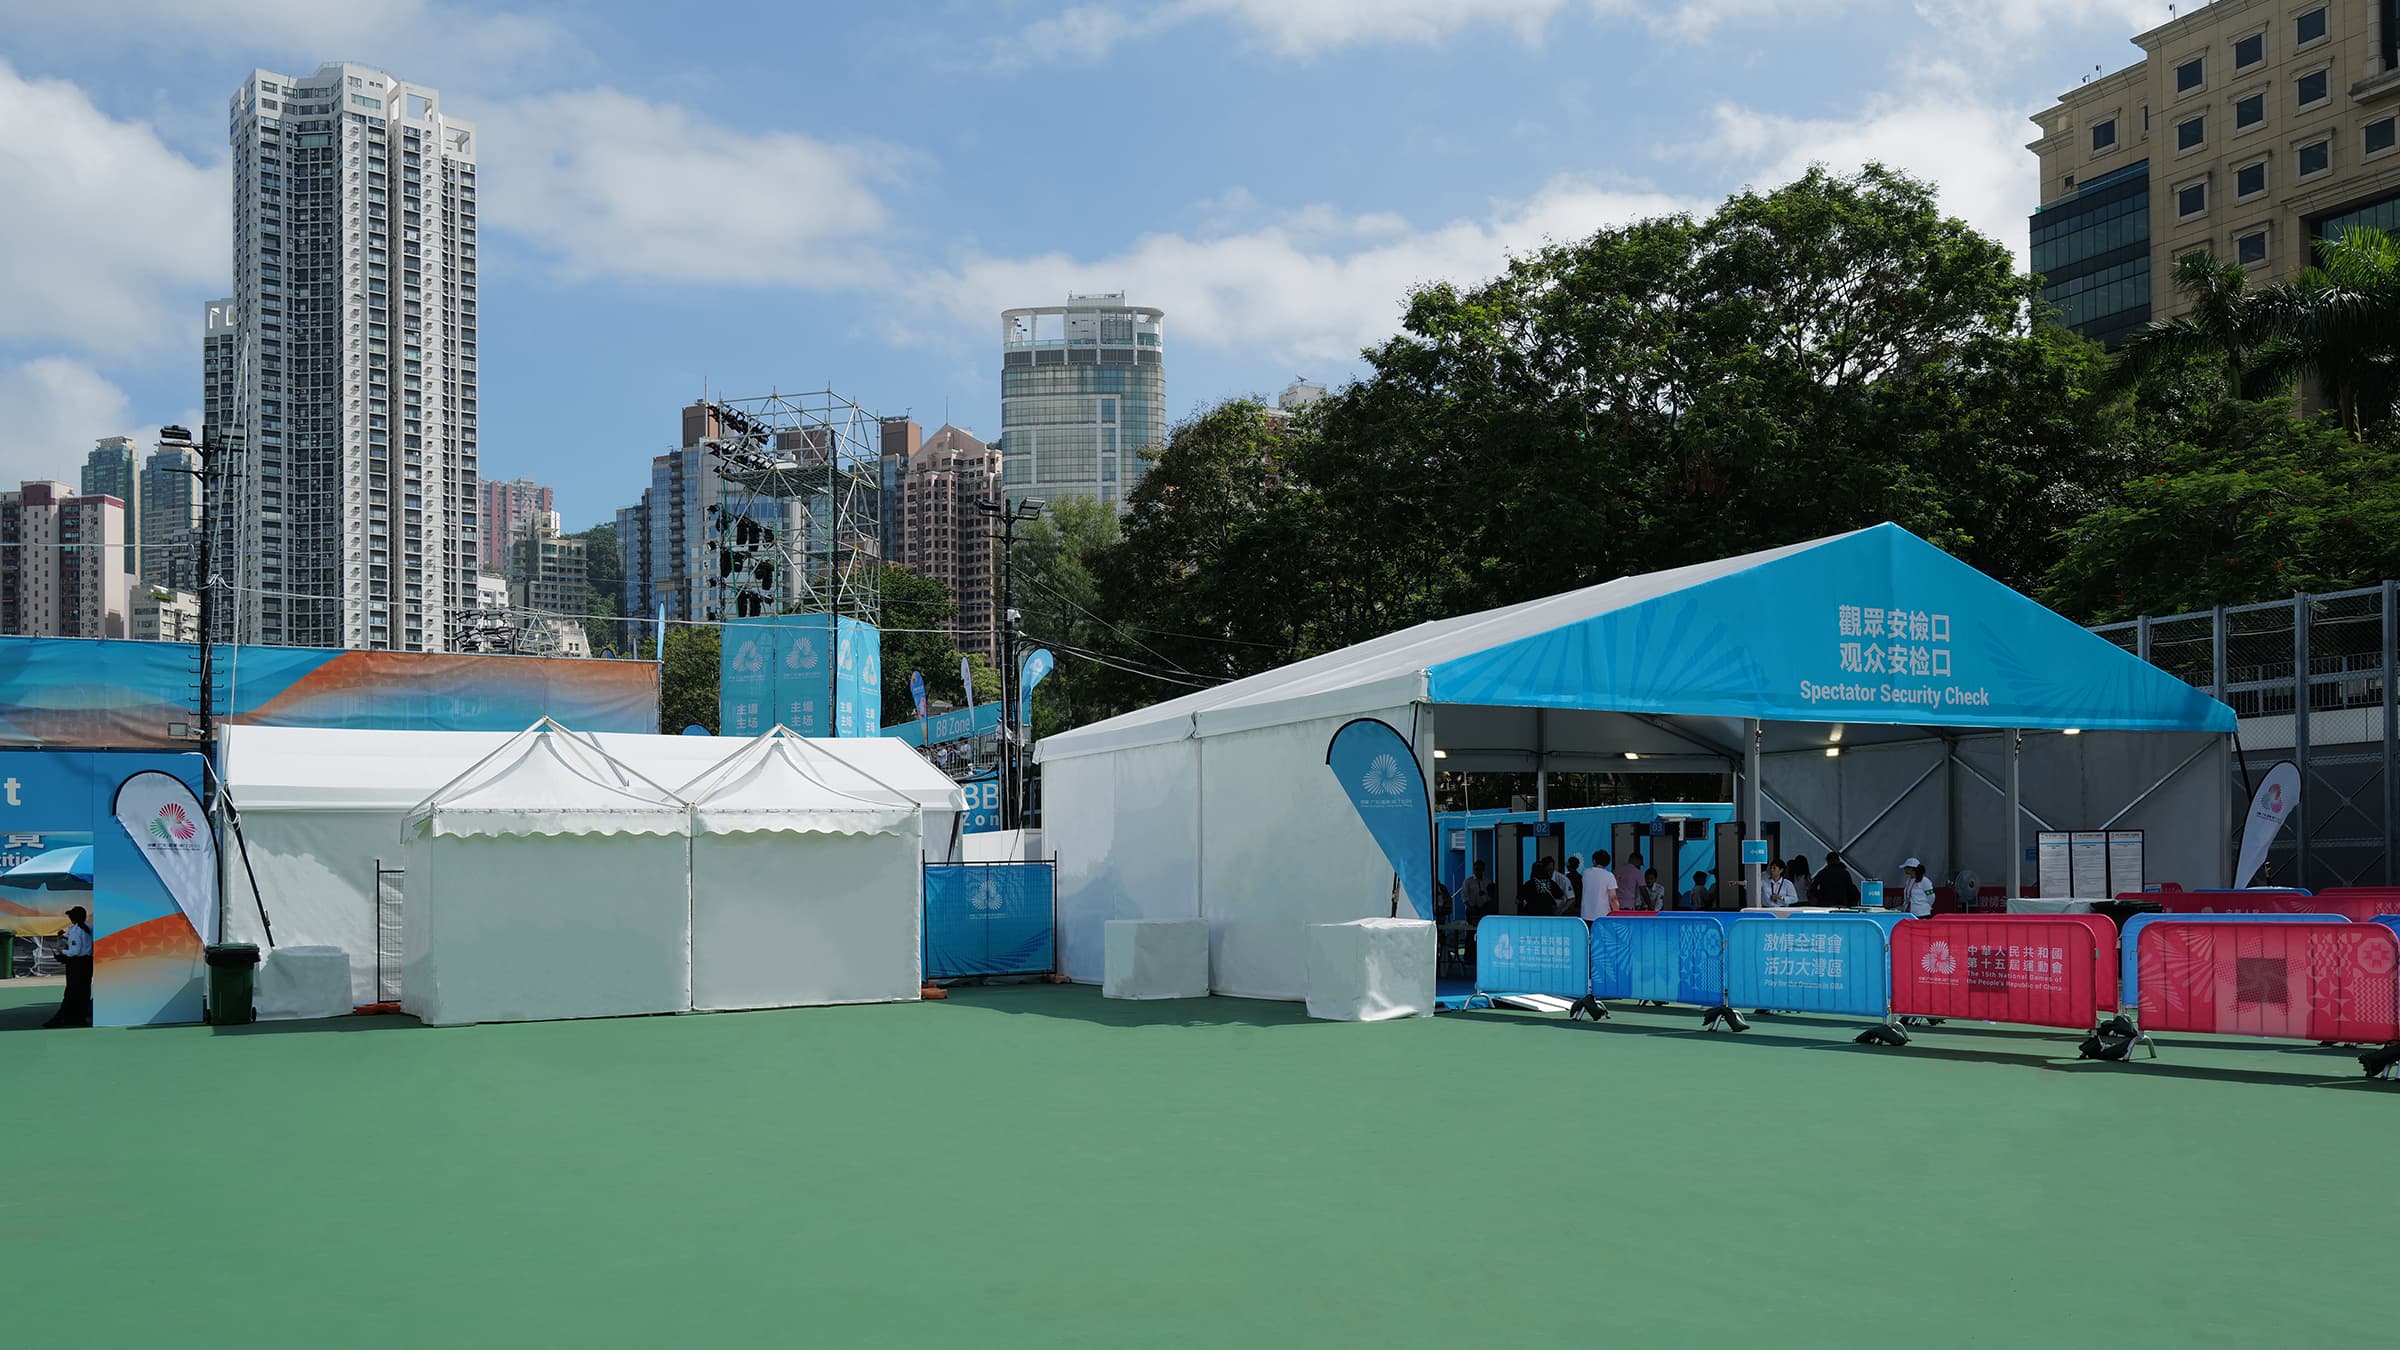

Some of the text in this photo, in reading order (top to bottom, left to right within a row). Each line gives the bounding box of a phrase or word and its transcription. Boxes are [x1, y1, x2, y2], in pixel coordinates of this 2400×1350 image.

[1839, 604, 1951, 643] 觀眾安檢口
[1839, 642, 1951, 678] 观众安检口
[1800, 680, 1989, 709] Spectator Security Check
[935, 717, 970, 738] BB Zone
[962, 783, 999, 810] BB
[1536, 823, 1547, 833] 02
[1763, 933, 1842, 954] 激情全運會
[1967, 944, 2063, 960] 中華人民共和國
[1764, 957, 1843, 978] 活力大灣區
